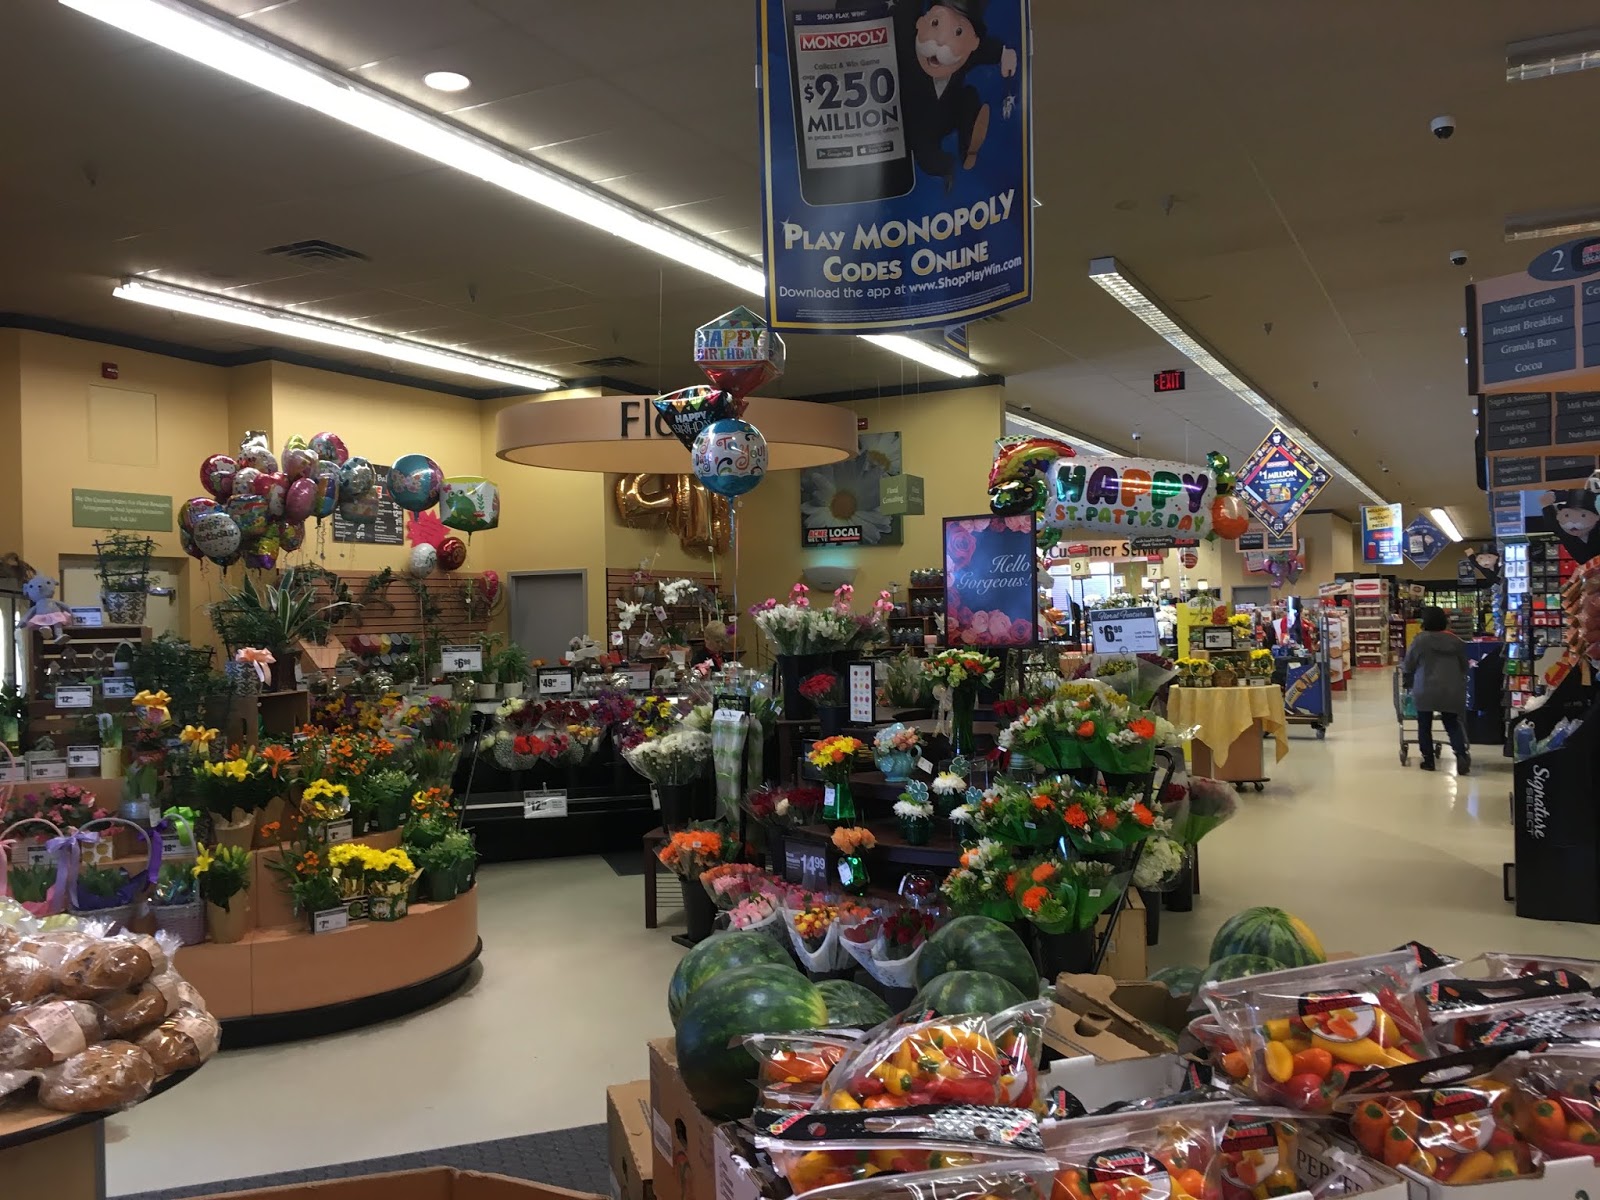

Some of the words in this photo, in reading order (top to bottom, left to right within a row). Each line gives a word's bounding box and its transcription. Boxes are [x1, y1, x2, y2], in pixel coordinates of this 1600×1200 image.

[802, 29, 886, 49] MONOPOLY
[814, 62, 837, 71] Collect
[859, 58, 880, 66] Game
[804, 67, 895, 110] $250
[808, 105, 899, 133] MILLION
[852, 189, 1015, 250] MONOPOLY
[1551, 249, 1565, 273] 2
[779, 286, 840, 299] Download
[843, 286, 863, 299] the
[867, 287, 891, 299] app
[894, 285, 906, 296] at
[909, 256, 1022, 293] www.ShopPlayWin.com
[1500, 300, 1527, 314] Natural
[1528, 295, 1556, 309] Cereals
[1492, 321, 1521, 336] Instant
[1523, 314, 1563, 331] Breakfast
[698, 329, 763, 348] HAPPY
[1500, 340, 1535, 354] Granola
[1537, 337, 1557, 349] Bars
[697, 347, 759, 361] BIRTHDAY
[1514, 361, 1543, 373] Cocoa
[1160, 372, 1180, 390] EXIT
[675, 411, 706, 424] HAPPY
[1500, 424, 1525, 432] Cooking
[1268, 470, 1298, 479] MILLION
[1056, 464, 1209, 514] HAPPY
[1055, 505, 1083, 522] ST.
[1086, 507, 1163, 528] PATTY'S
[1167, 512, 1205, 532] DAY
[829, 528, 860, 538] LOCAL
[1050, 545, 1117, 559] Cumer
[990, 554, 1031, 574] Hello
[1074, 562, 1081, 572] 9
[1152, 568, 1158, 578] 7
[957, 572, 1032, 595] Gorgeous!
[1526, 764, 1550, 839] Signature
[1525, 787, 1534, 836] SELECT
